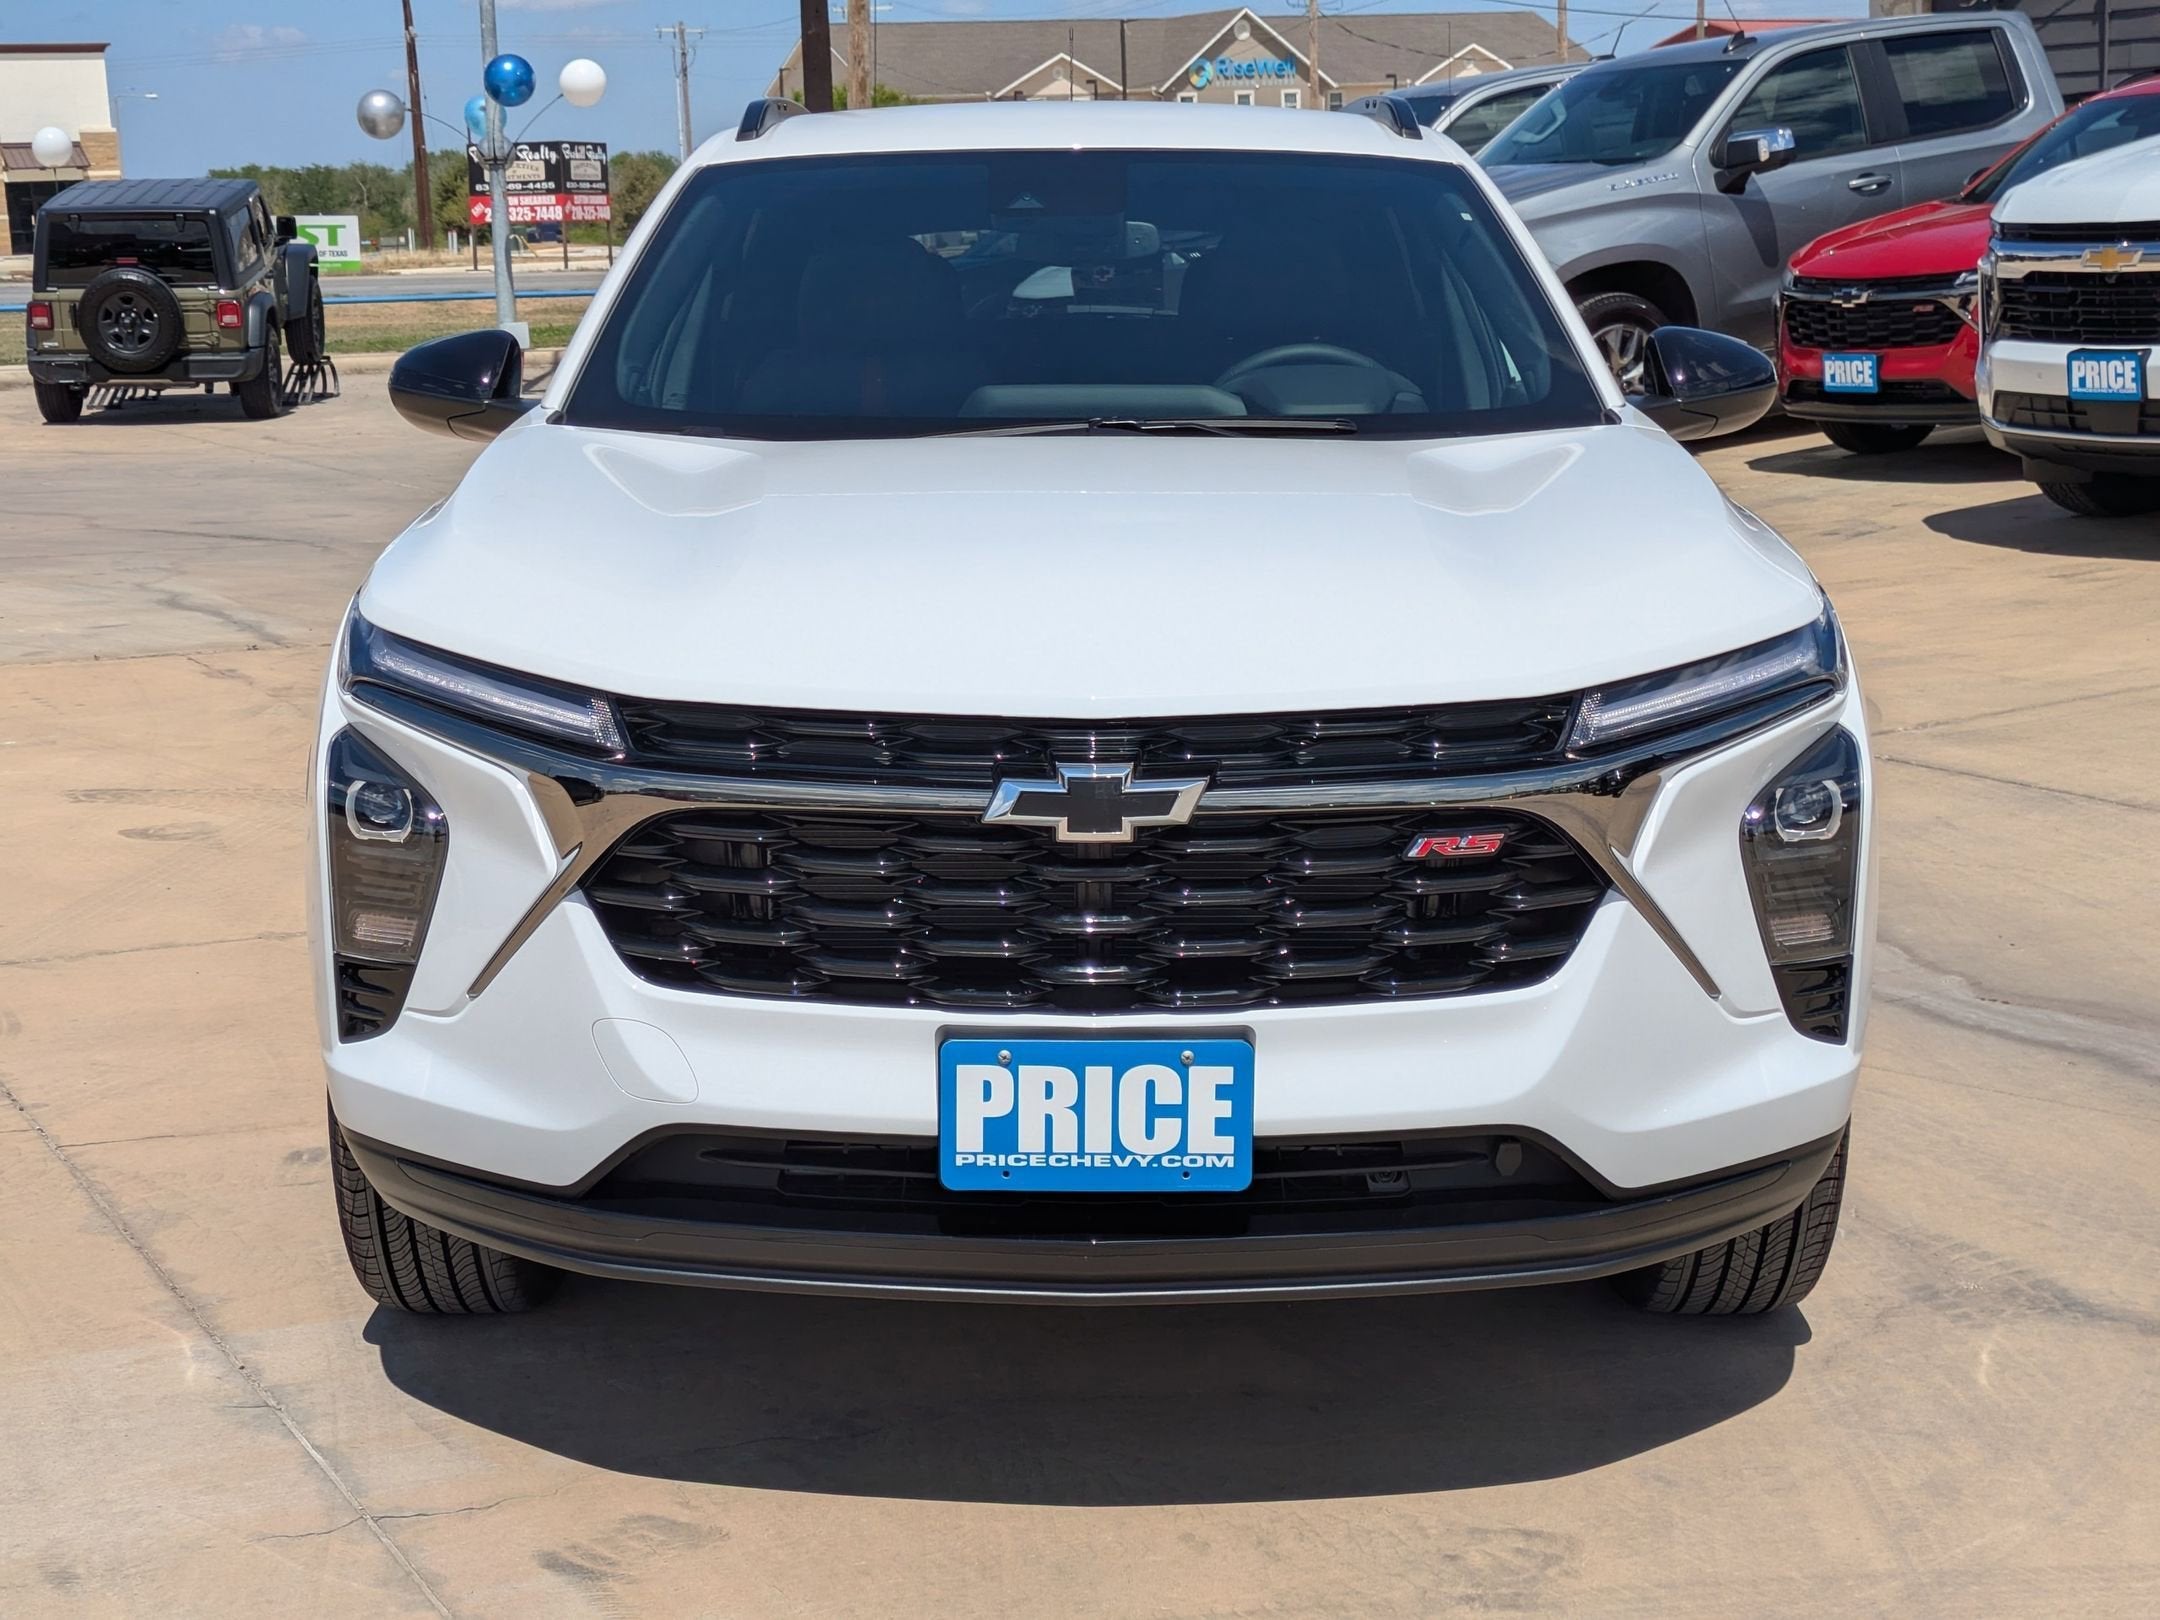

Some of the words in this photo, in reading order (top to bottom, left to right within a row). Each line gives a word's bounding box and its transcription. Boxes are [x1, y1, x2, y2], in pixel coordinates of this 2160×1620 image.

[1216, 57, 1296, 79] RiseWell
[516, 145, 558, 165] Realty
[475, 181, 556, 192] 8369-4455
[484, 205, 563, 222] 2325-7448
[298, 225, 346, 247] ST
[1824, 360, 1873, 385] PRICE
[2071, 360, 2137, 390] PRICE
[1407, 834, 1505, 857] RS
[956, 1064, 1235, 1155] PRICE
[955, 1154, 1235, 1168] PRICECHEVY.COM
